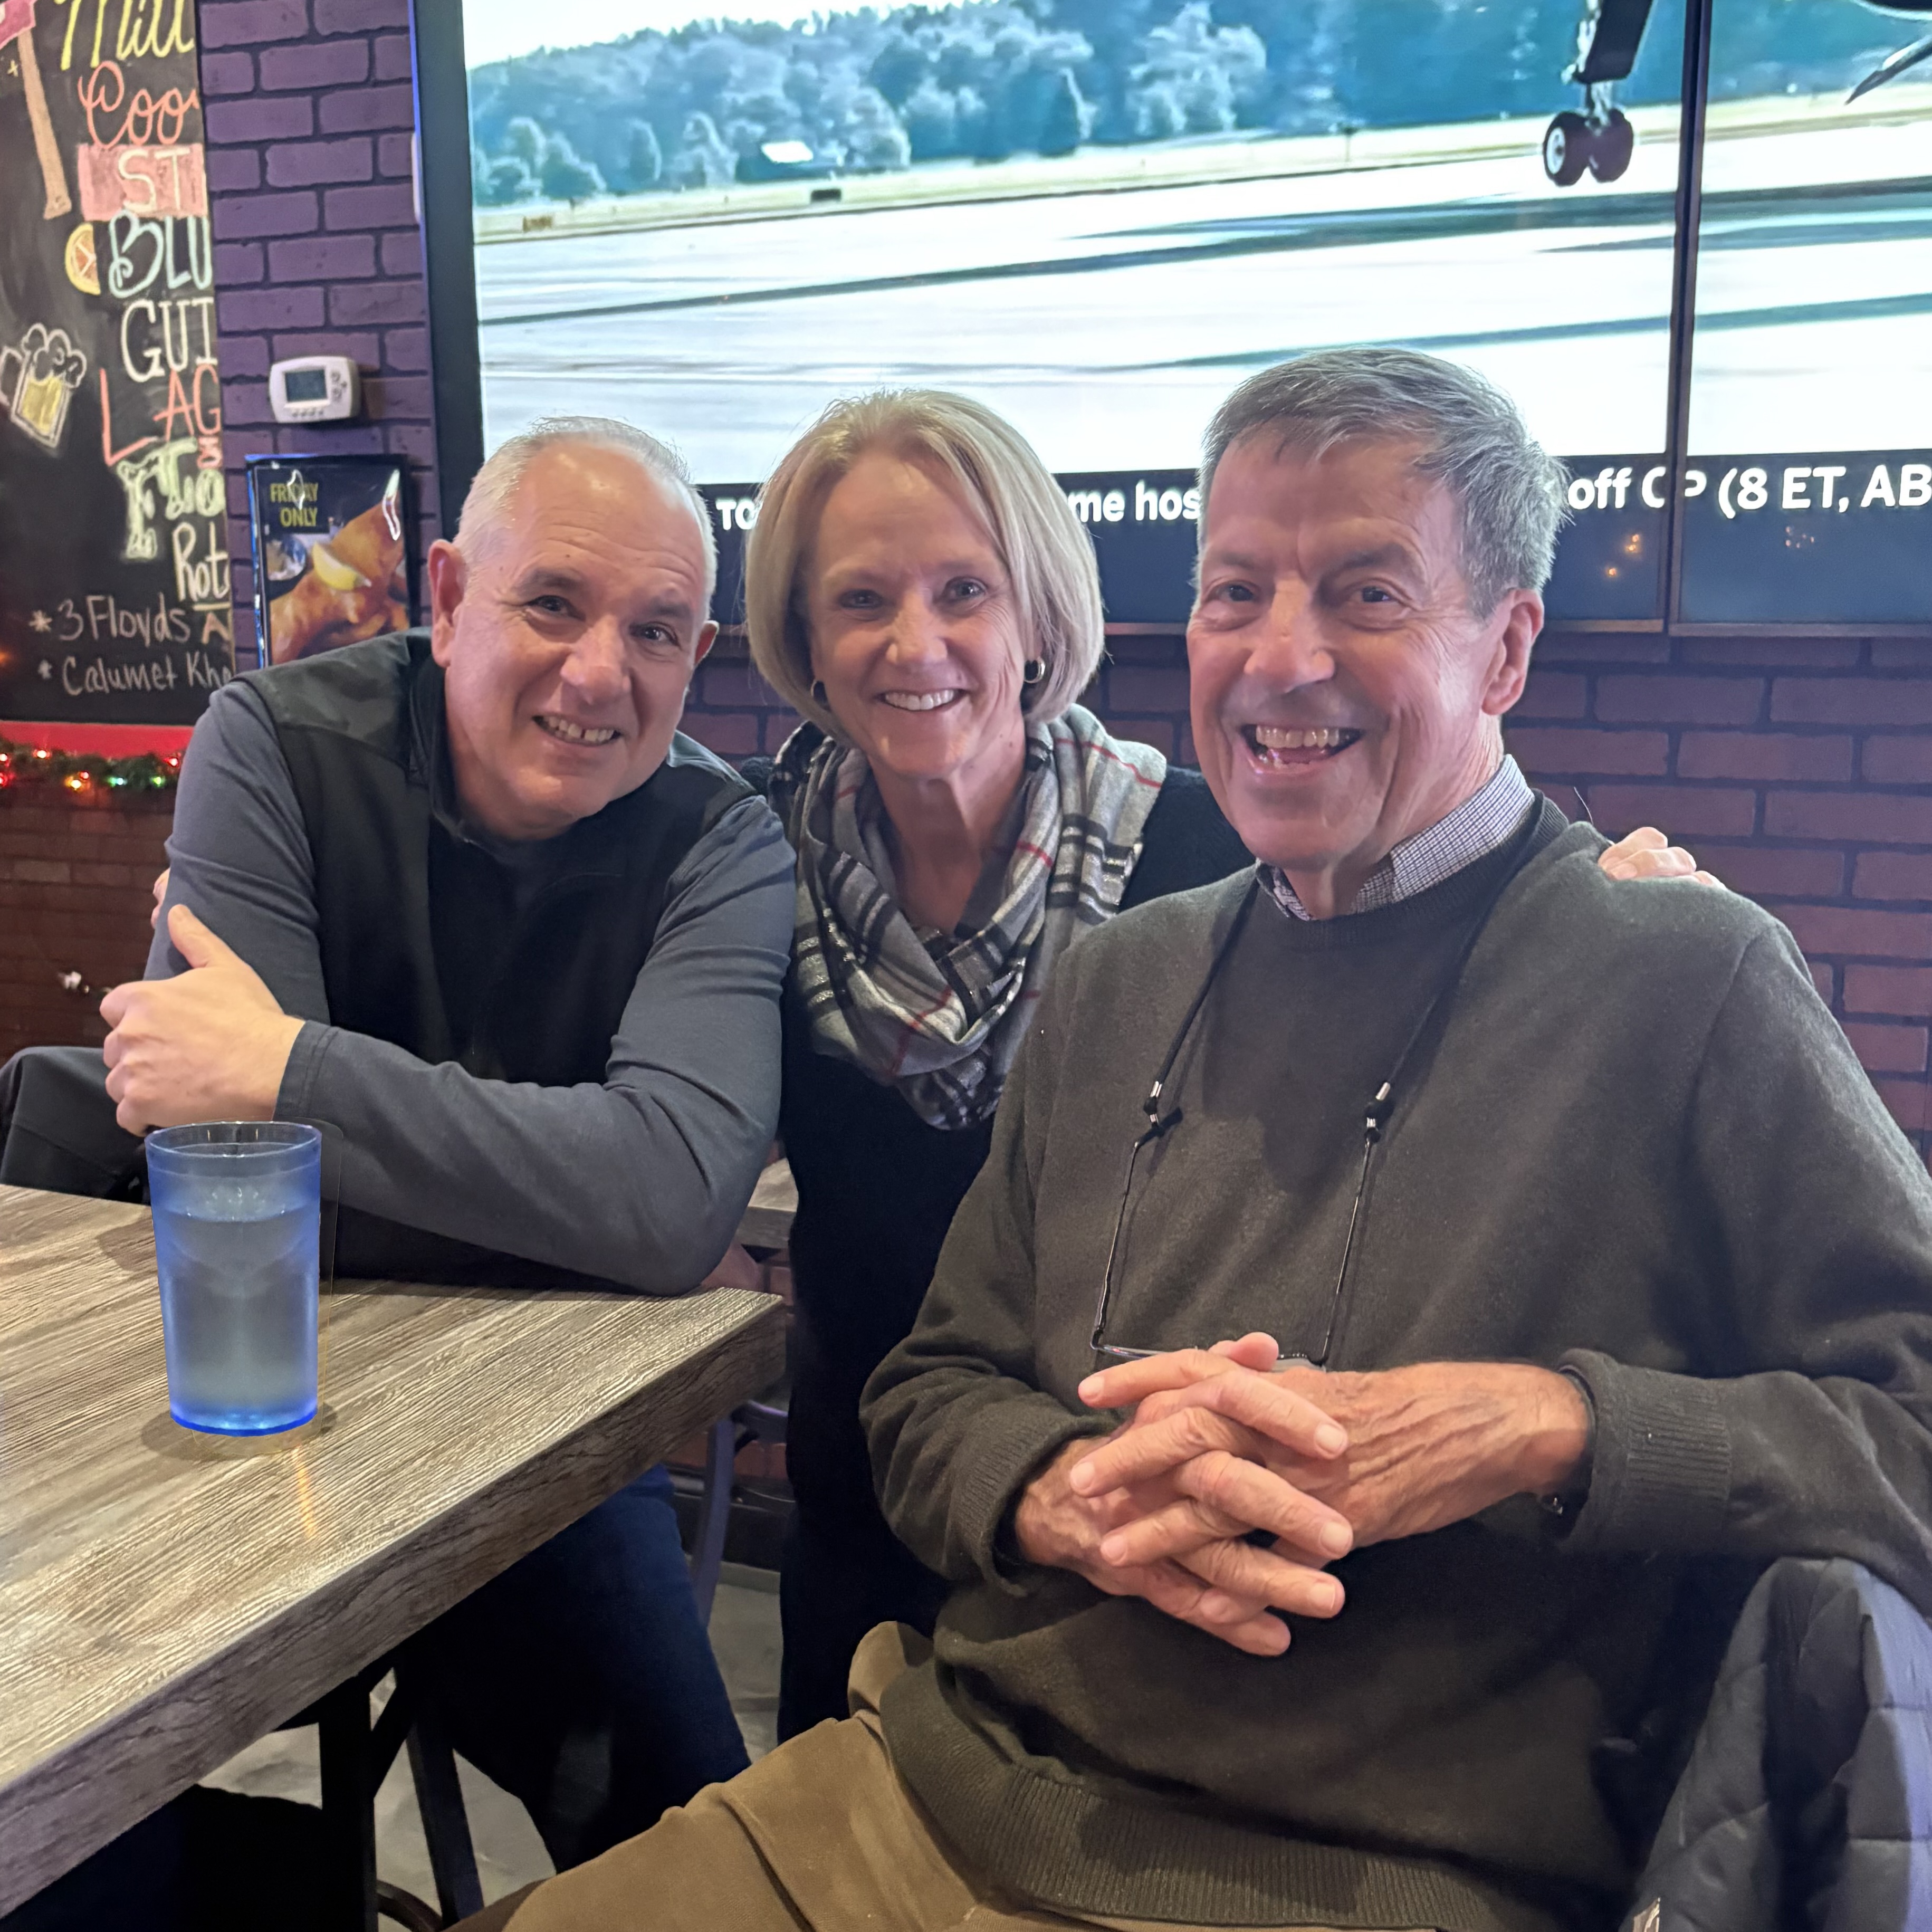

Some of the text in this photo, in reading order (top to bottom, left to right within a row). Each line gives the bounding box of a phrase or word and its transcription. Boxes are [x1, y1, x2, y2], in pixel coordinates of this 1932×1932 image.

[109, 209, 212, 298] BLU
[280, 506, 318, 527] ONLY
[1567, 467, 1633, 510] off
[1718, 467, 1767, 519] (8
[1783, 466, 1849, 513] ET,
[58, 599, 84, 641] 3
[85, 592, 191, 648] Floyds
[62, 655, 178, 696] Calumet
